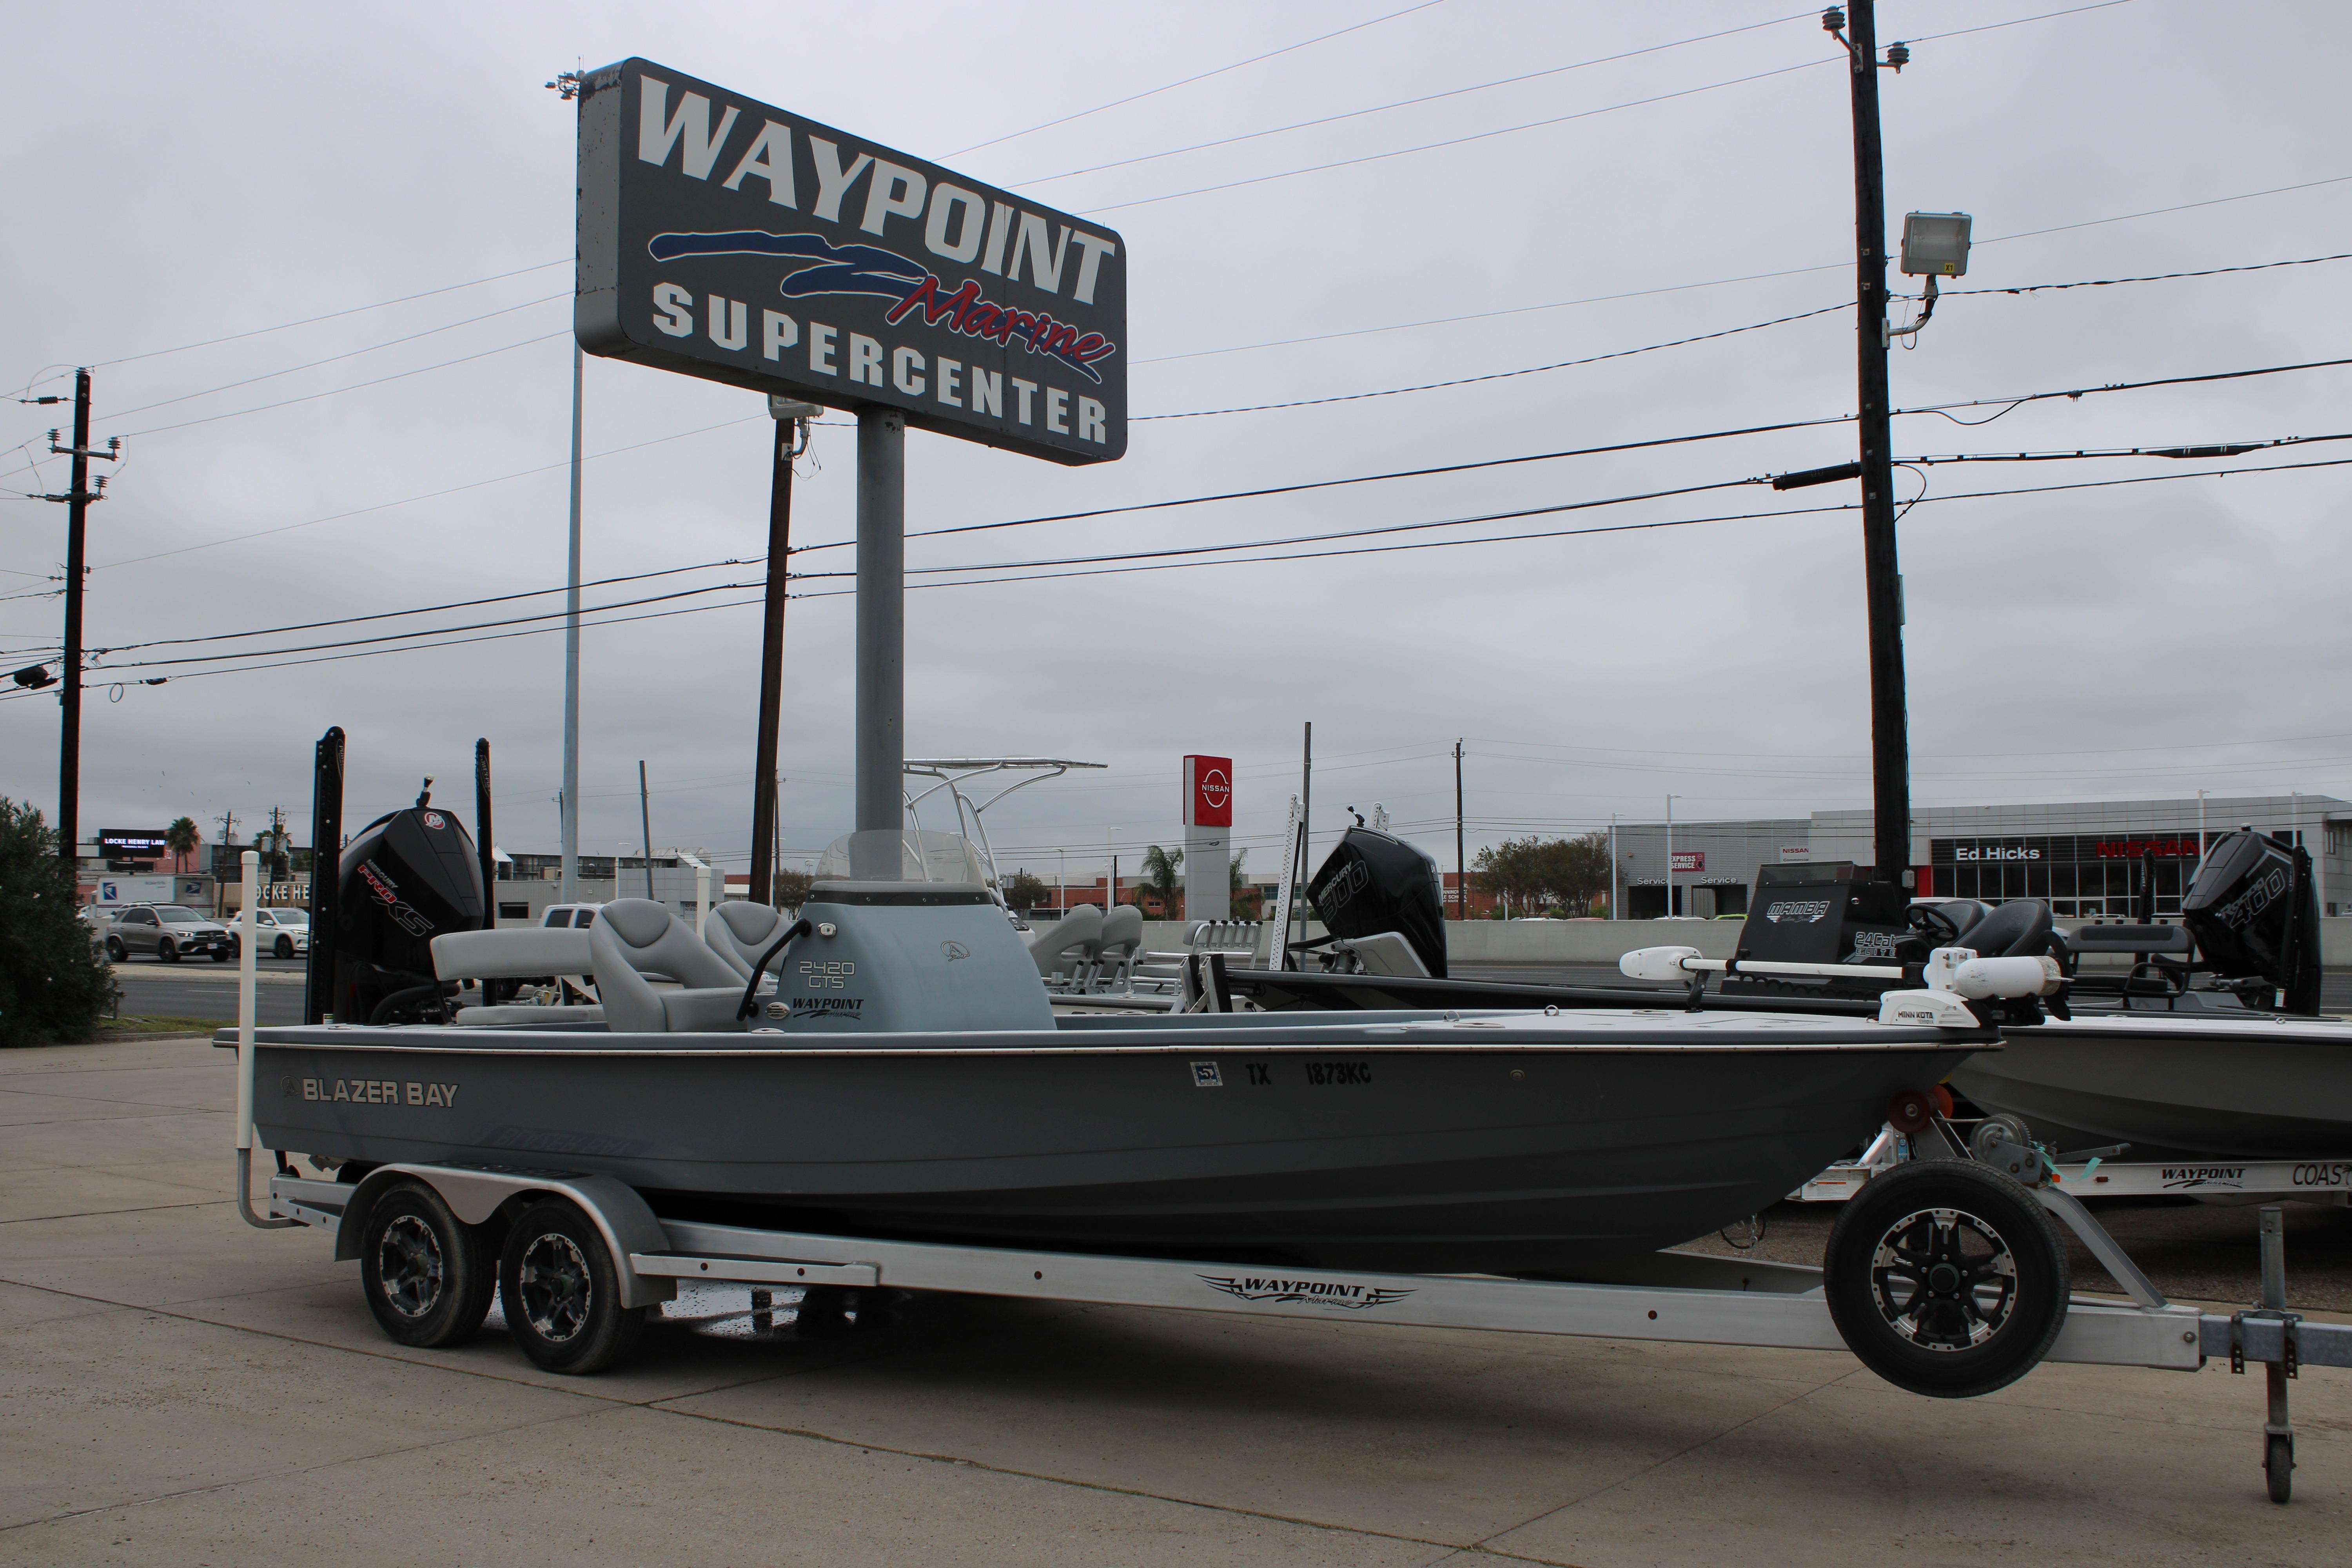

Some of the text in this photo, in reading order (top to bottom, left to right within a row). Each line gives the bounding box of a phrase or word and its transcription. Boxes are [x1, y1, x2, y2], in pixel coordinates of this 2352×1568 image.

[639, 74, 1115, 305] WAYPOINT
[886, 276, 1116, 362] Marine
[653, 282, 1106, 444] SUPERCENTER
[1956, 847, 2040, 860] Ed Hicks
[2096, 840, 2200, 857] NISSAN
[358, 864, 397, 904] PRO
[366, 858, 398, 888] MERCURY
[1318, 861, 1352, 904] MERCURY
[1318, 860, 1368, 924] 300
[2229, 868, 2285, 928] 400
[370, 896, 435, 936] XS
[1767, 901, 1830, 915] MAMBA
[1856, 947, 1895, 956] ELITE
[799, 961, 855, 975] 2420
[809, 975, 844, 989] GTS
[793, 998, 864, 1009] WAYPOINT
[1201, 1066, 1211, 1079] 5
[1245, 1062, 1272, 1085] TX
[1305, 1062, 1371, 1085] 1873KC
[303, 1078, 459, 1108] BLAZER BAY
[2161, 1168, 2245, 1179] WAYPOINT
[1245, 1278, 1365, 1297] WAYPOINT
